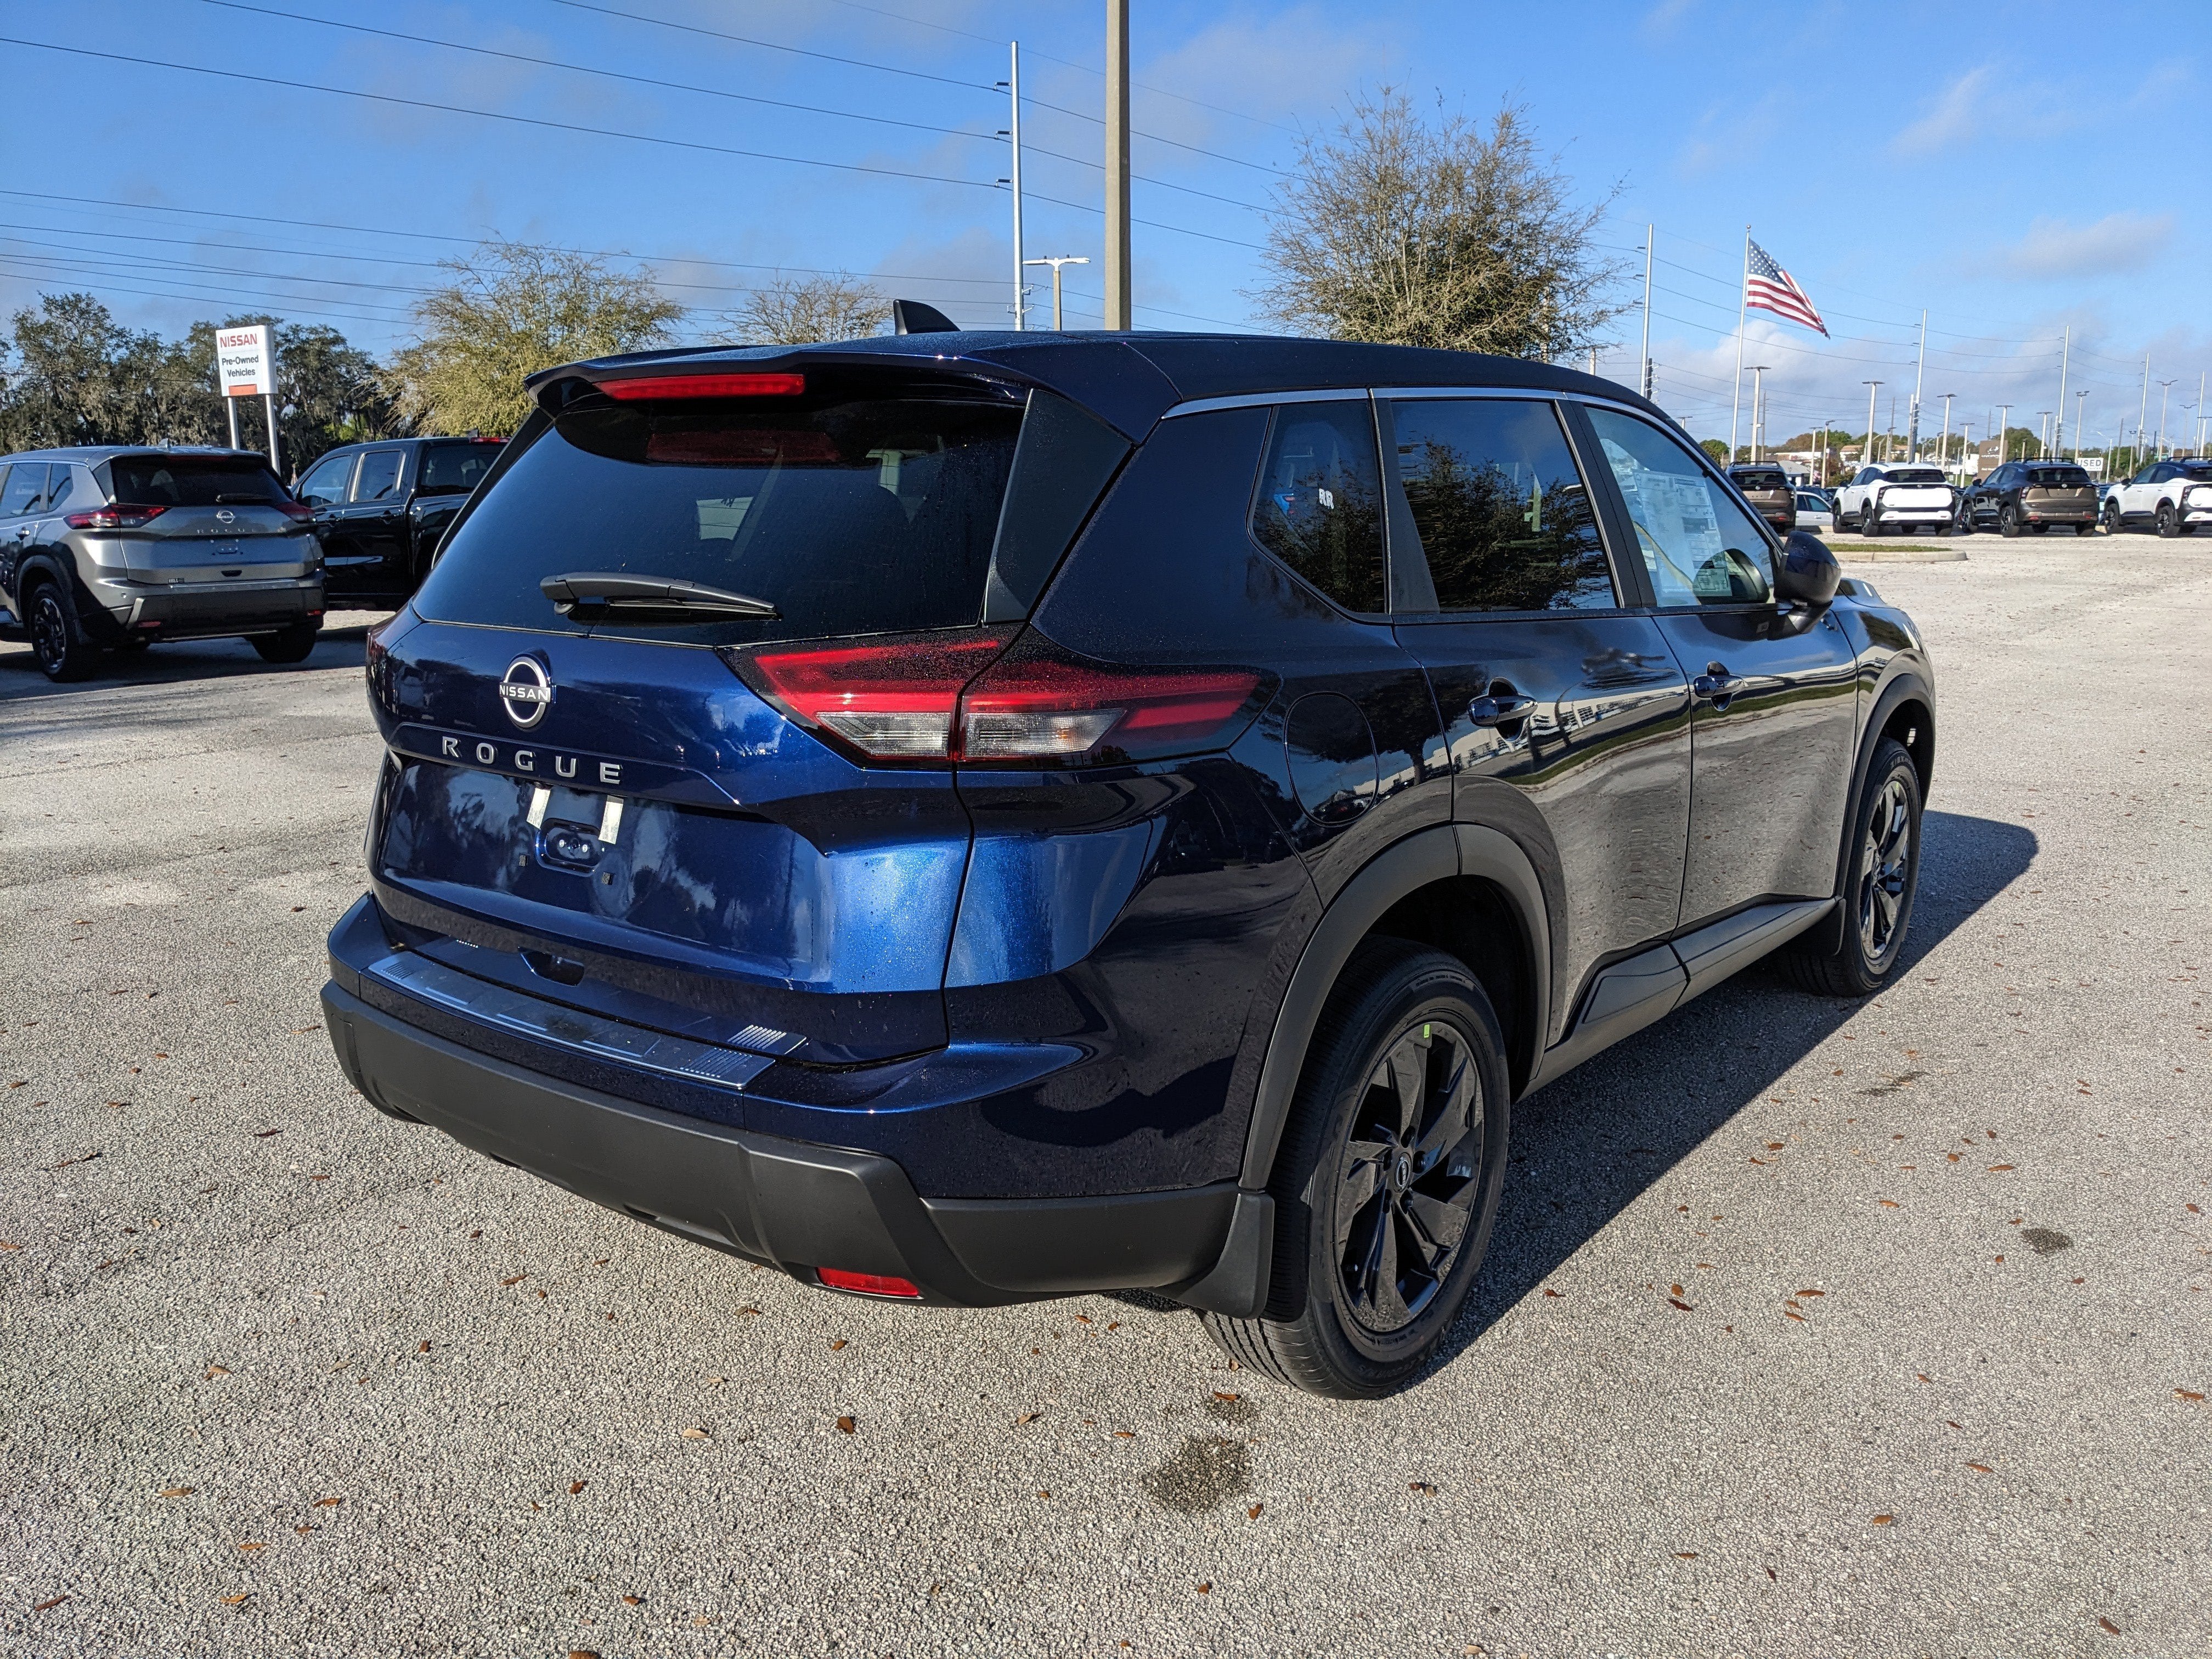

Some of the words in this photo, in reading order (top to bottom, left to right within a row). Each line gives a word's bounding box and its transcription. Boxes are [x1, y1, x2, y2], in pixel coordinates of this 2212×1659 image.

[220, 334, 257, 348] NISSAN
[222, 355, 259, 366] Pre-Owned
[227, 368, 256, 377] Vehicles
[1319, 488, 1334, 509] RR
[499, 685, 548, 701] NISSAN
[442, 736, 621, 785] ROGUE
